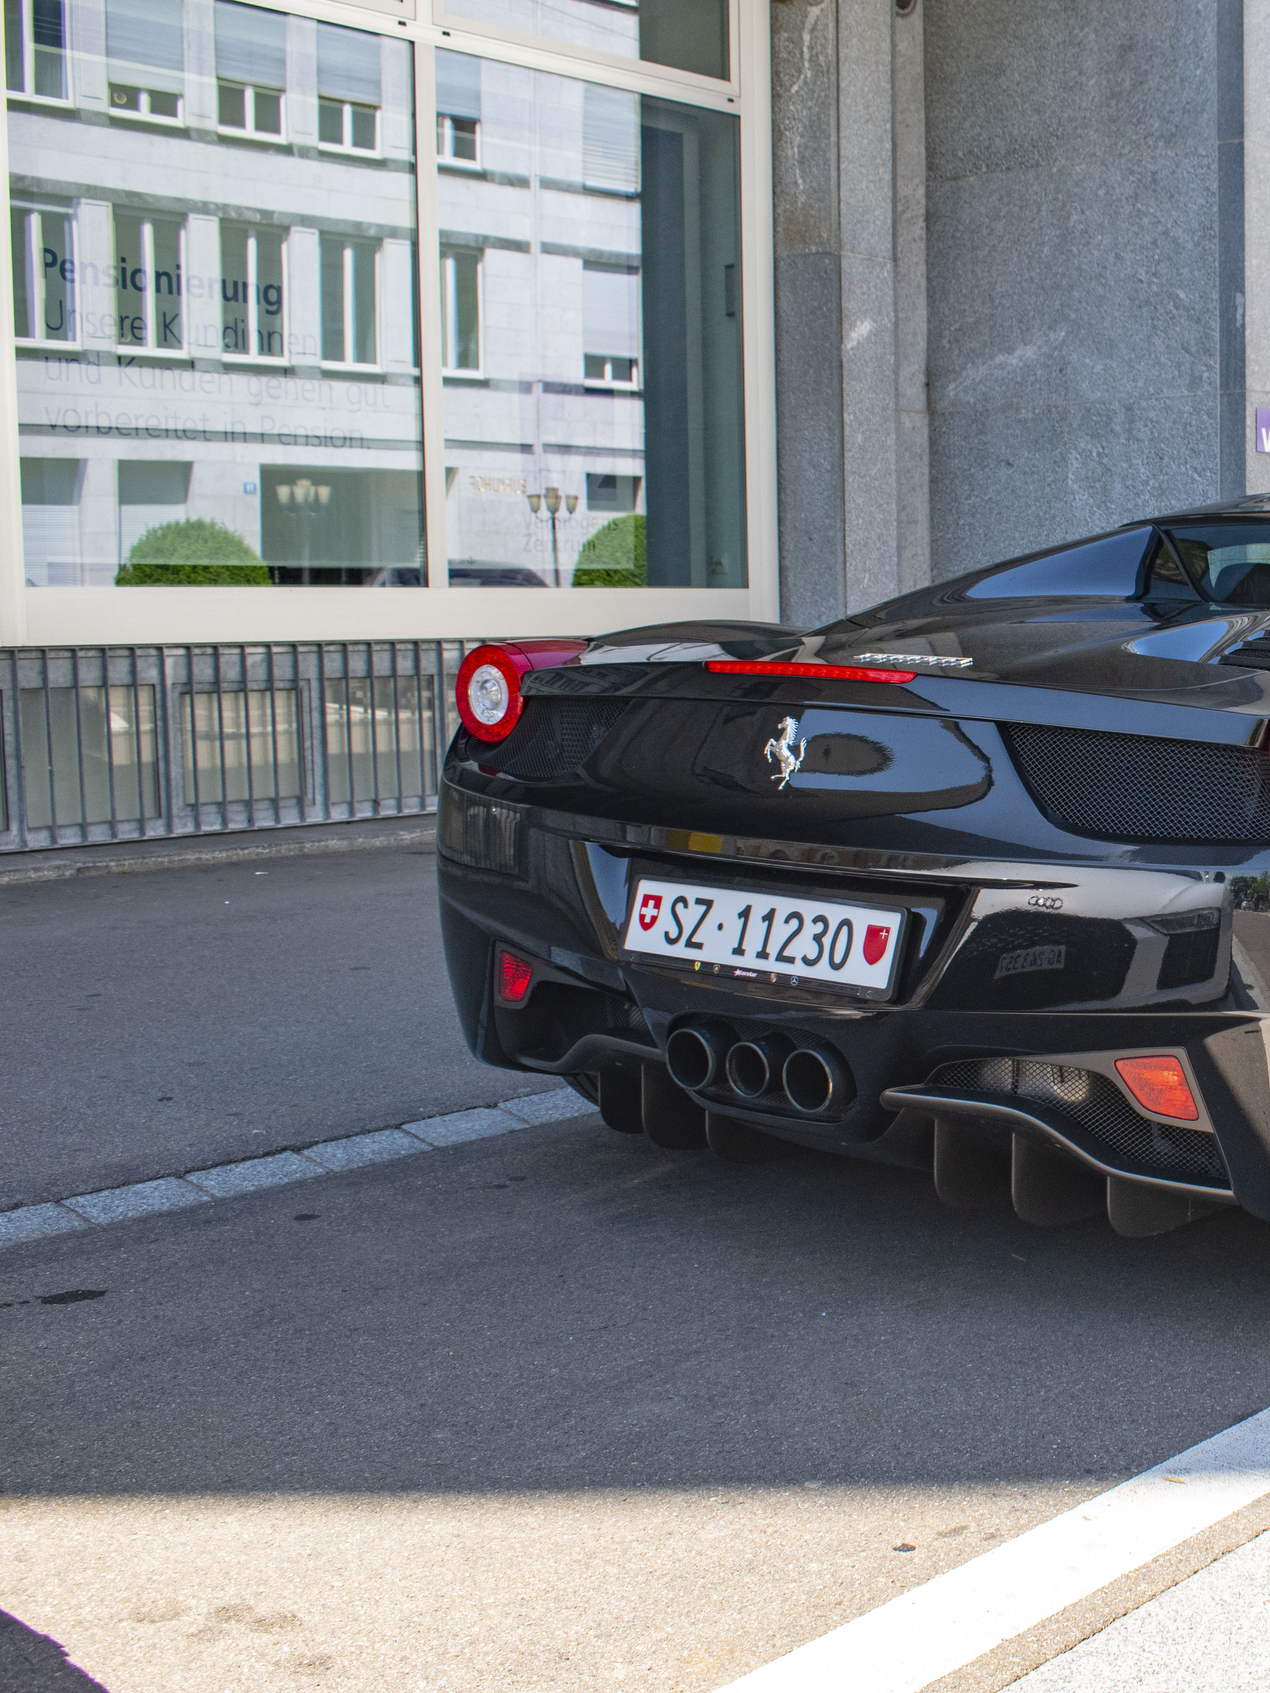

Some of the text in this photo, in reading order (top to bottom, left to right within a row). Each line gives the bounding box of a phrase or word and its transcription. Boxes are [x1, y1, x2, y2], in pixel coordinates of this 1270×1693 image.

[42, 248, 284, 315] Pensionierung
[45, 299, 318, 356] Unsere Kundinnen
[45, 354, 389, 413] und Kunden gehen gut
[44, 402, 371, 450] vorbereitet in Pension.
